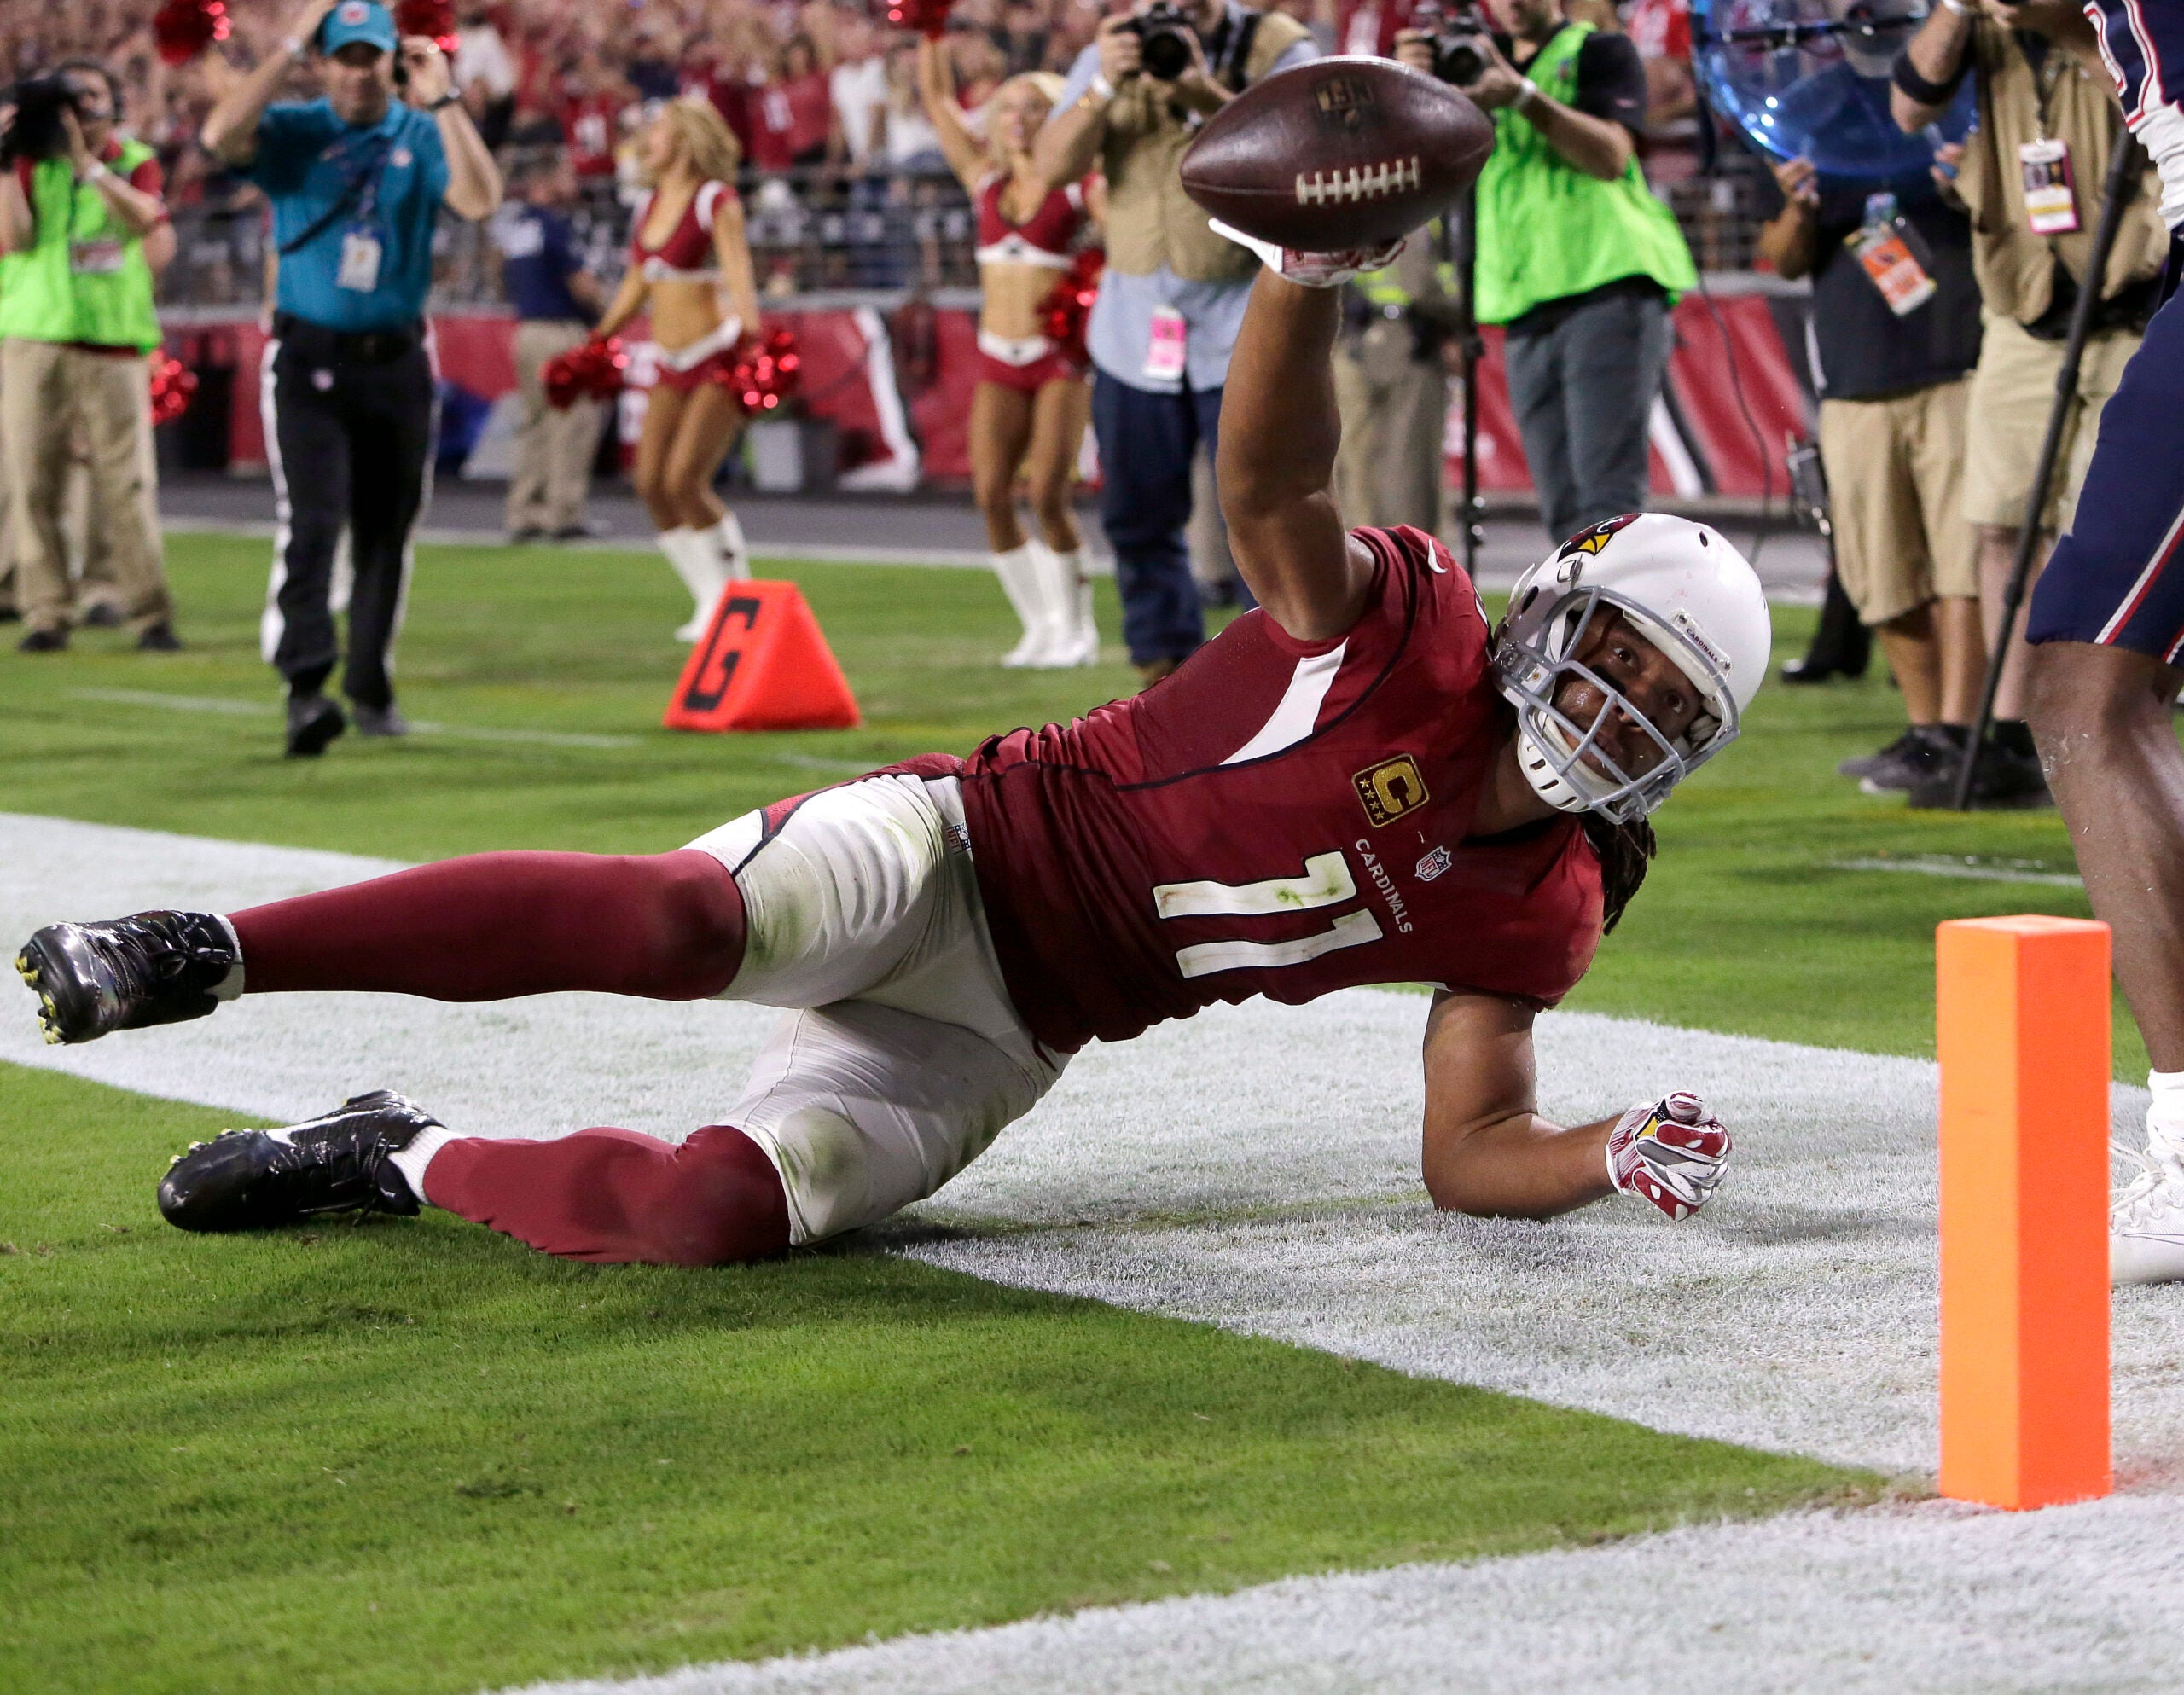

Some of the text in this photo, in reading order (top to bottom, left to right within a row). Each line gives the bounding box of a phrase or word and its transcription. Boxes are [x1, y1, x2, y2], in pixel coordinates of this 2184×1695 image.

[684, 598, 761, 711] G
[1687, 629, 1718, 663] CARDINALS
[1373, 762, 1422, 814] C
[1153, 850, 1384, 979] 11
[1356, 839, 1413, 933] CARDINALS
